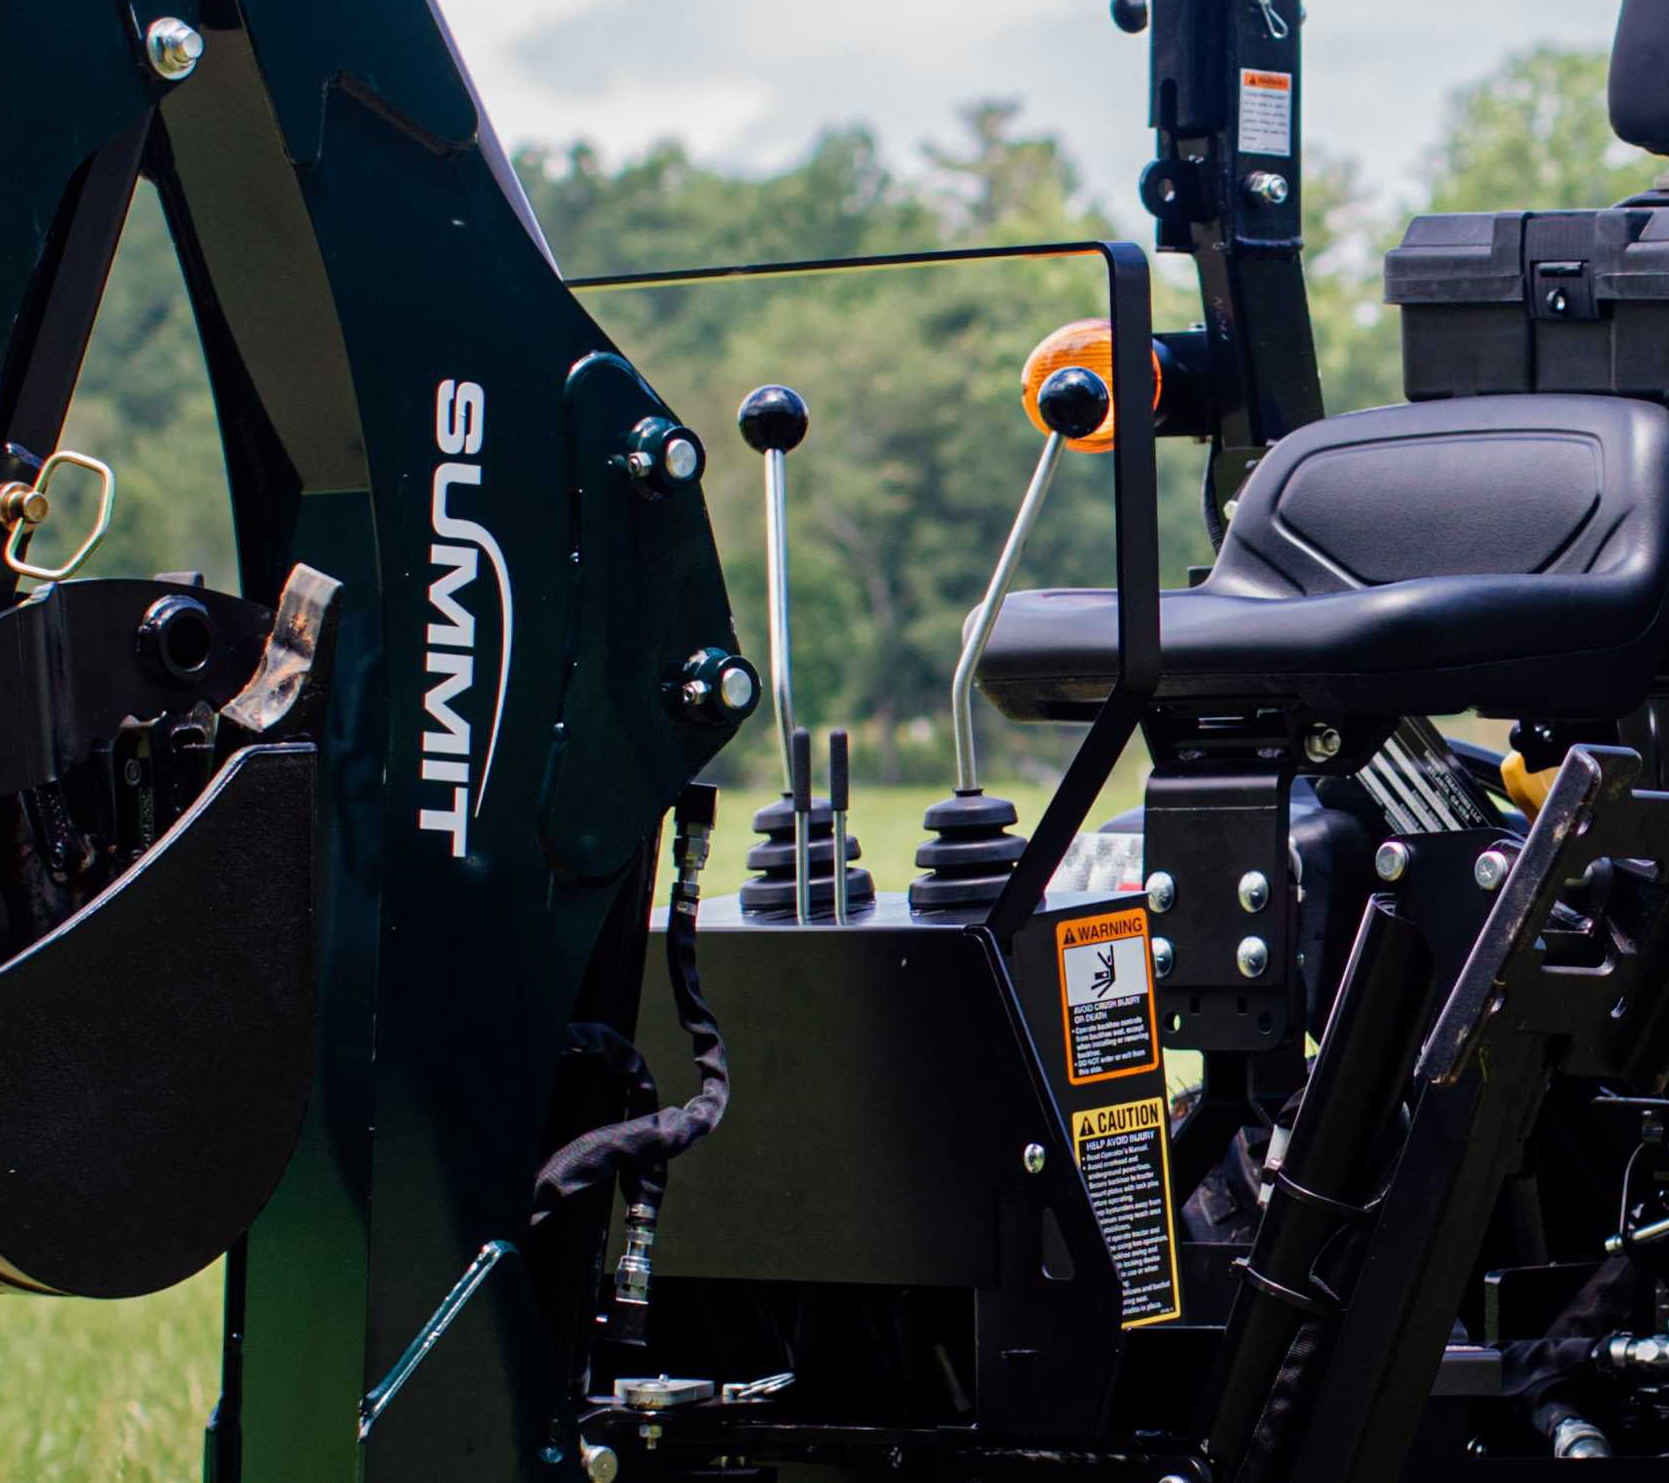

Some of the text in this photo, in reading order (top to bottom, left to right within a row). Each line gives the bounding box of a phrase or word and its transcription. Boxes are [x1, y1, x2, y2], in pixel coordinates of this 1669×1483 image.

[419, 379, 513, 857] SUMMIT
[1444, 772, 1472, 811] TRACTORS
[1470, 805, 1482, 824] LLC
[1450, 795, 1459, 807] GA
[1457, 805, 1471, 821] USA
[1077, 917, 1142, 941] WARNING
[1074, 995, 1141, 1015] AVOID CRUSH INJURY
[1074, 1011, 1107, 1024] OR DEATH
[1078, 1059, 1087, 1068] DO
[1087, 1057, 1100, 1066] NOT
[1097, 1102, 1159, 1134] CAUTION
[1086, 1129, 1155, 1152] HELP AVOID INJURY
